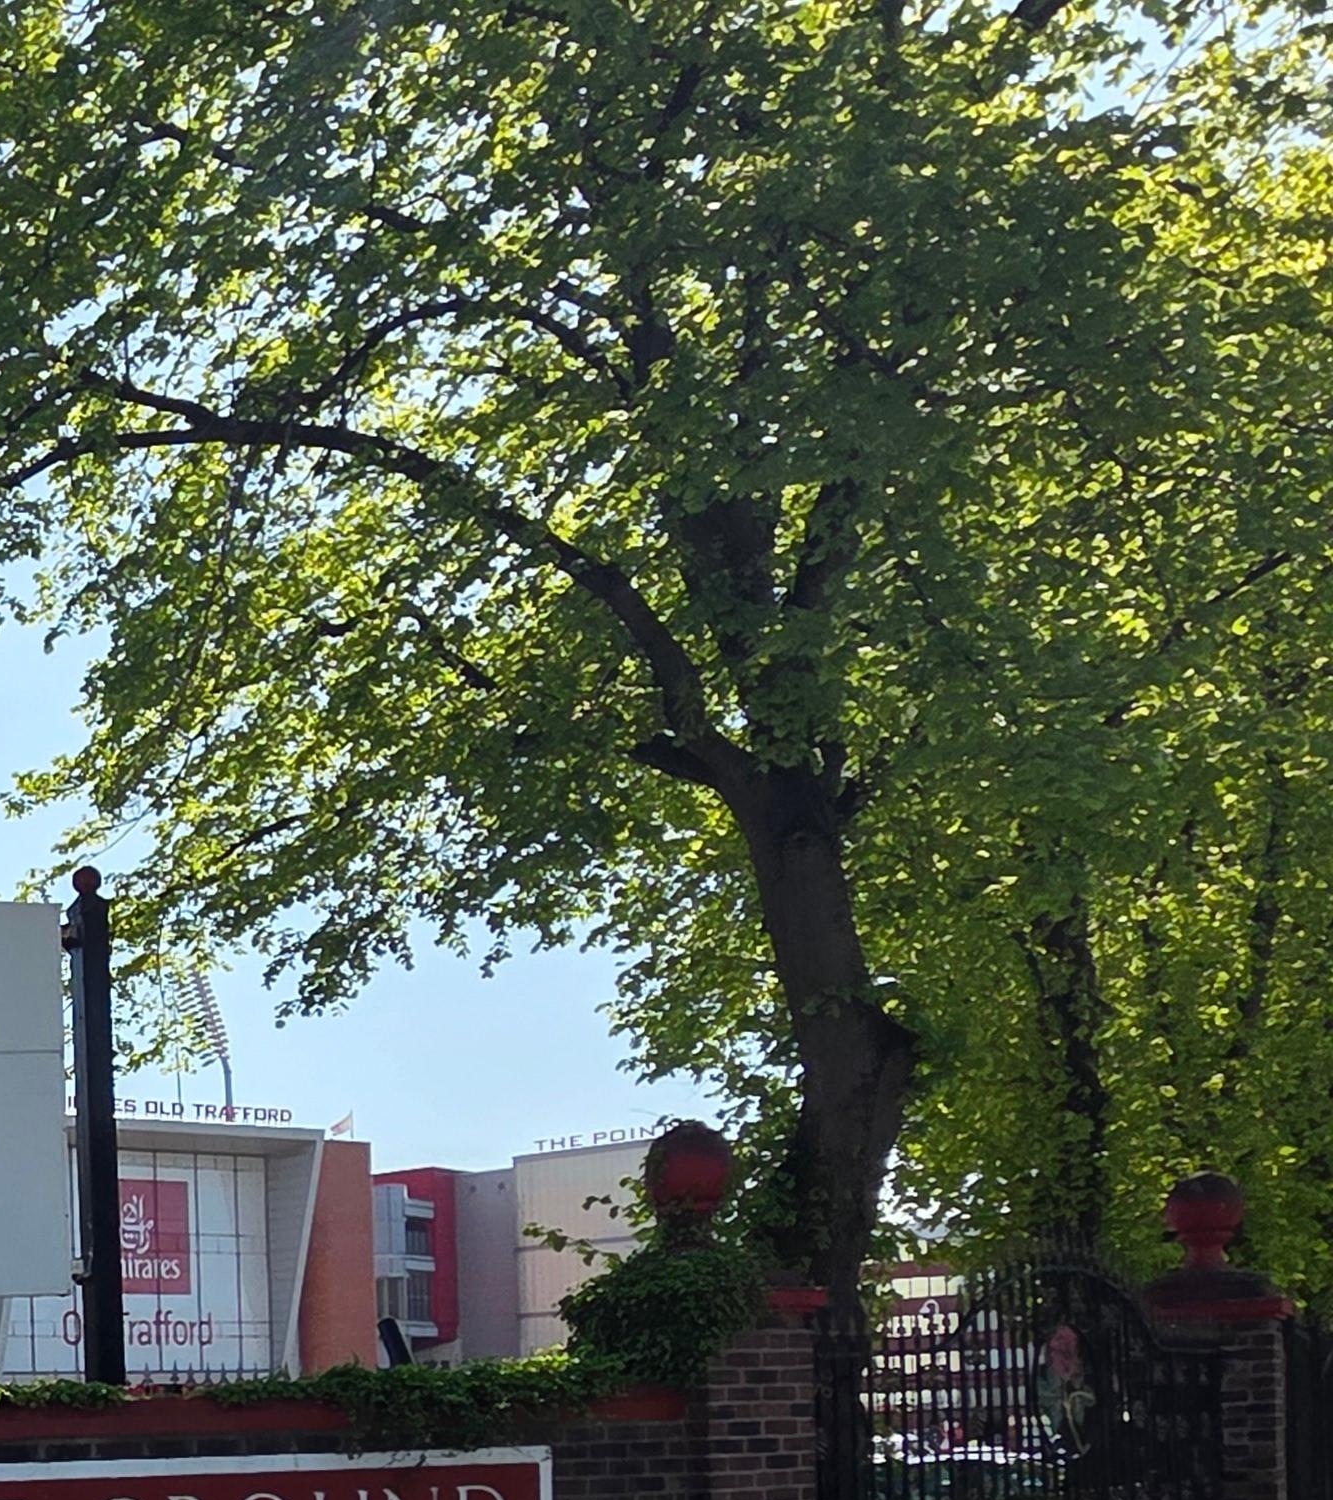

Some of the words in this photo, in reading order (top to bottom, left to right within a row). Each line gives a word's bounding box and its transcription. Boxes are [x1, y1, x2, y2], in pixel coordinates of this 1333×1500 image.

[145, 1100, 184, 1116] OLD
[192, 1103, 293, 1123] TRAFFORD
[533, 1134, 583, 1151] THE
[123, 1309, 214, 1346] rafford
